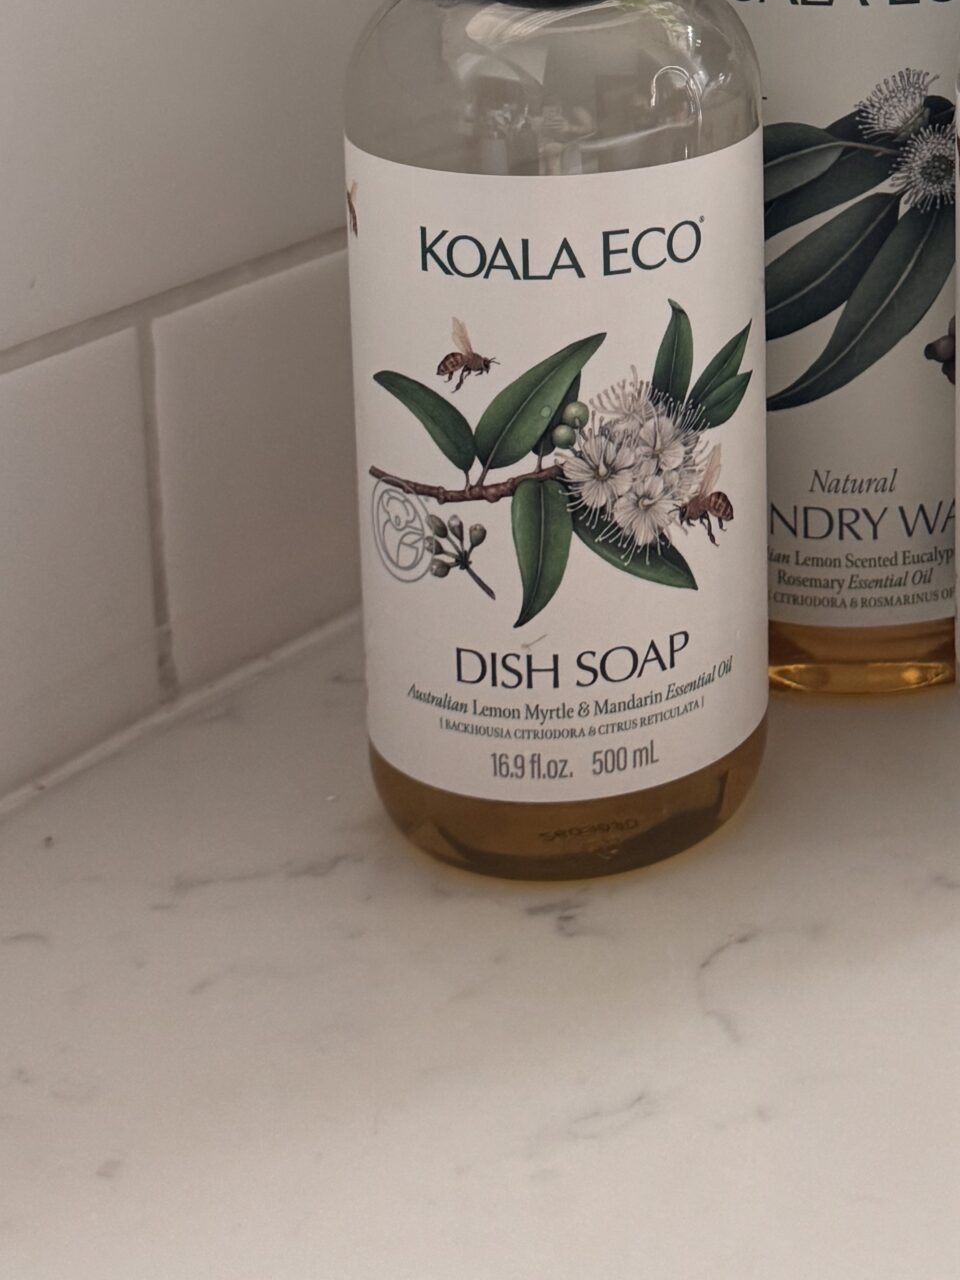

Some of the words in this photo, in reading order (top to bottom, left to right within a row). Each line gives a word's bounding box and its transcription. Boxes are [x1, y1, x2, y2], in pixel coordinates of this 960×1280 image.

[419, 226, 586, 280] KOALA
[808, 468, 898, 494] Natural
[769, 501, 889, 541] NDRY
[795, 550, 842, 569] Lemon
[845, 550, 898, 569] Scented
[777, 569, 845, 594] Rosemary
[847, 570, 909, 590] Essential
[912, 567, 934, 586] Oil
[860, 589, 939, 609] ROSMARINUS
[456, 647, 559, 689] DISH
[575, 630, 689, 687] SOAP
[407, 683, 468, 714] Australian
[472, 699, 521, 719] Lemon
[525, 702, 574, 725] Myrtle
[577, 701, 590, 718] &
[594, 690, 663, 717] Mandarin
[665, 665, 717, 701] Essential
[717, 655, 733, 677] Oil
[514, 727, 585, 740] CITRIODORA
[588, 726, 596, 737] &
[598, 719, 638, 736] CITRUS
[640, 699, 700, 728] RETICULATA
[490, 751, 525, 779] 16.9
[529, 752, 574, 780] fl.oz.
[591, 746, 628, 775] 500
[632, 740, 660, 768] mL
